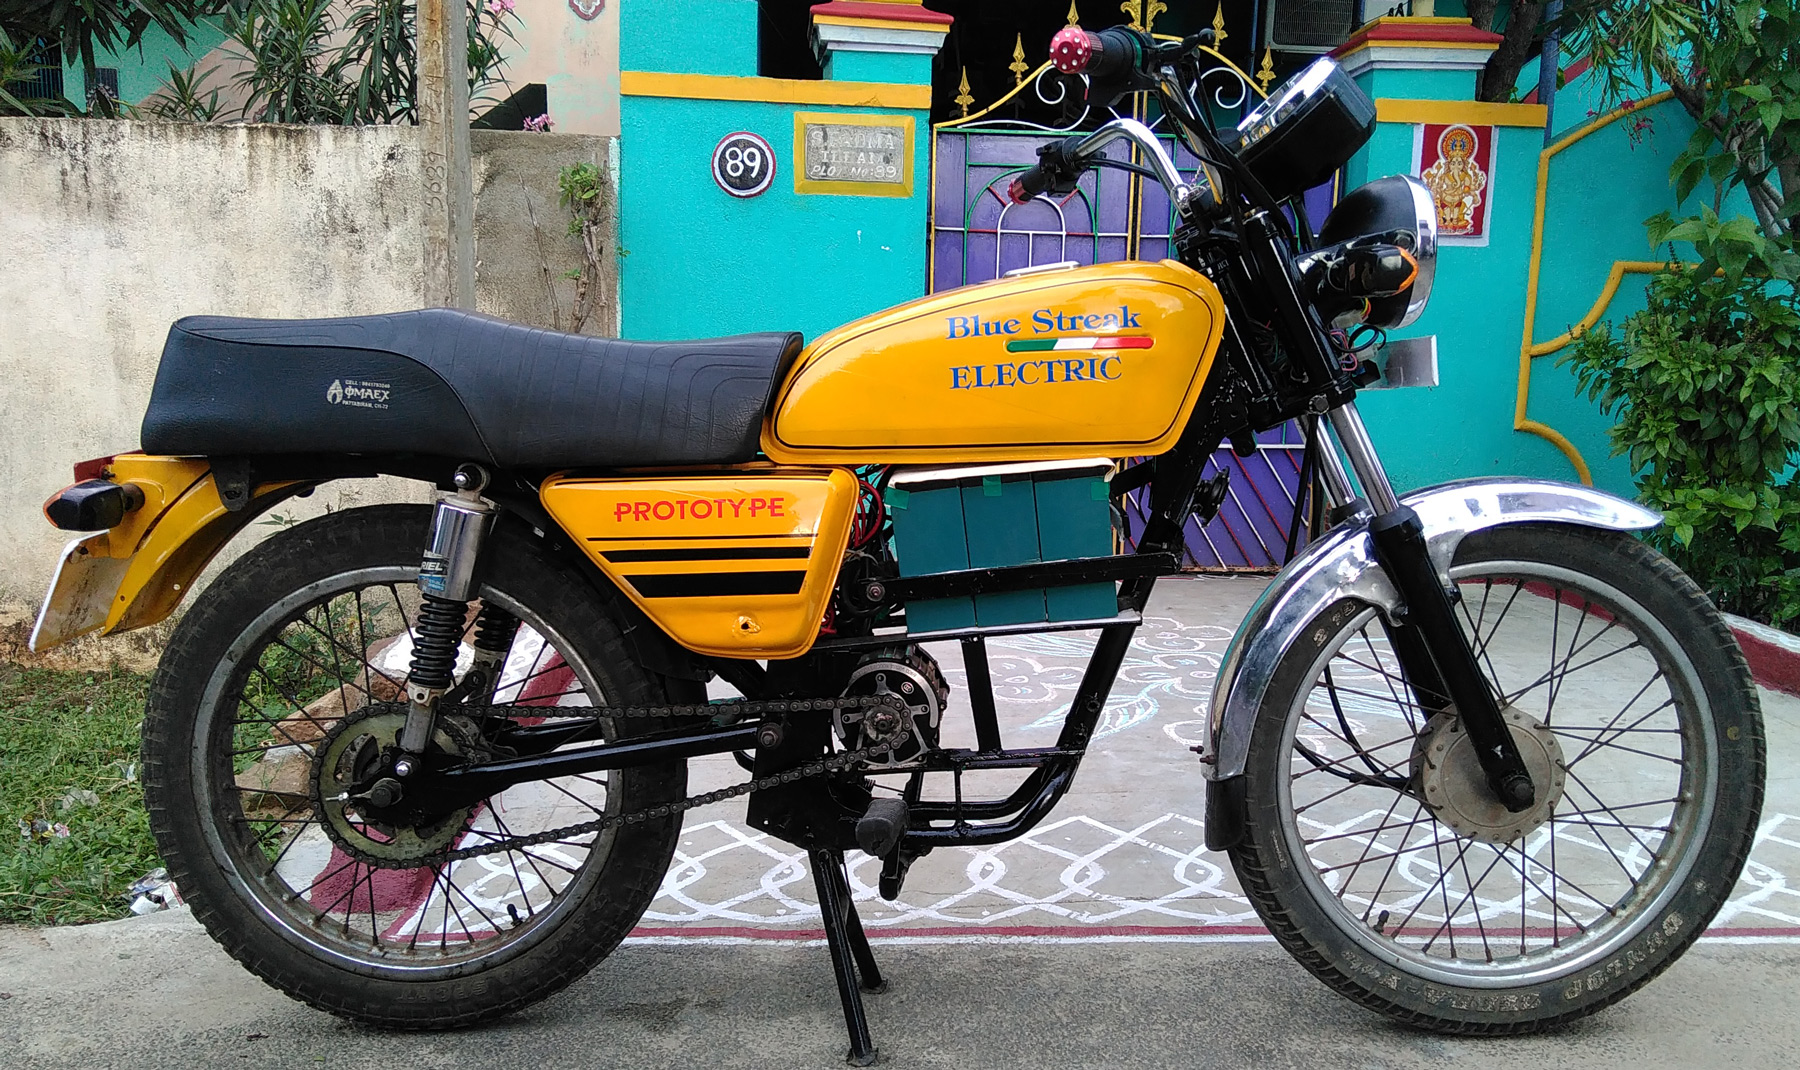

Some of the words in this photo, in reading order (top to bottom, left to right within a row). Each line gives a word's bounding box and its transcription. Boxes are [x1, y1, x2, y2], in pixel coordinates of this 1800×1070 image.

[725, 147, 761, 179] 89
[945, 314, 1021, 339] Blue
[1032, 306, 1142, 334] Streak
[949, 356, 1122, 390] ELECTRIC
[614, 497, 785, 522] PROTOTYPE
